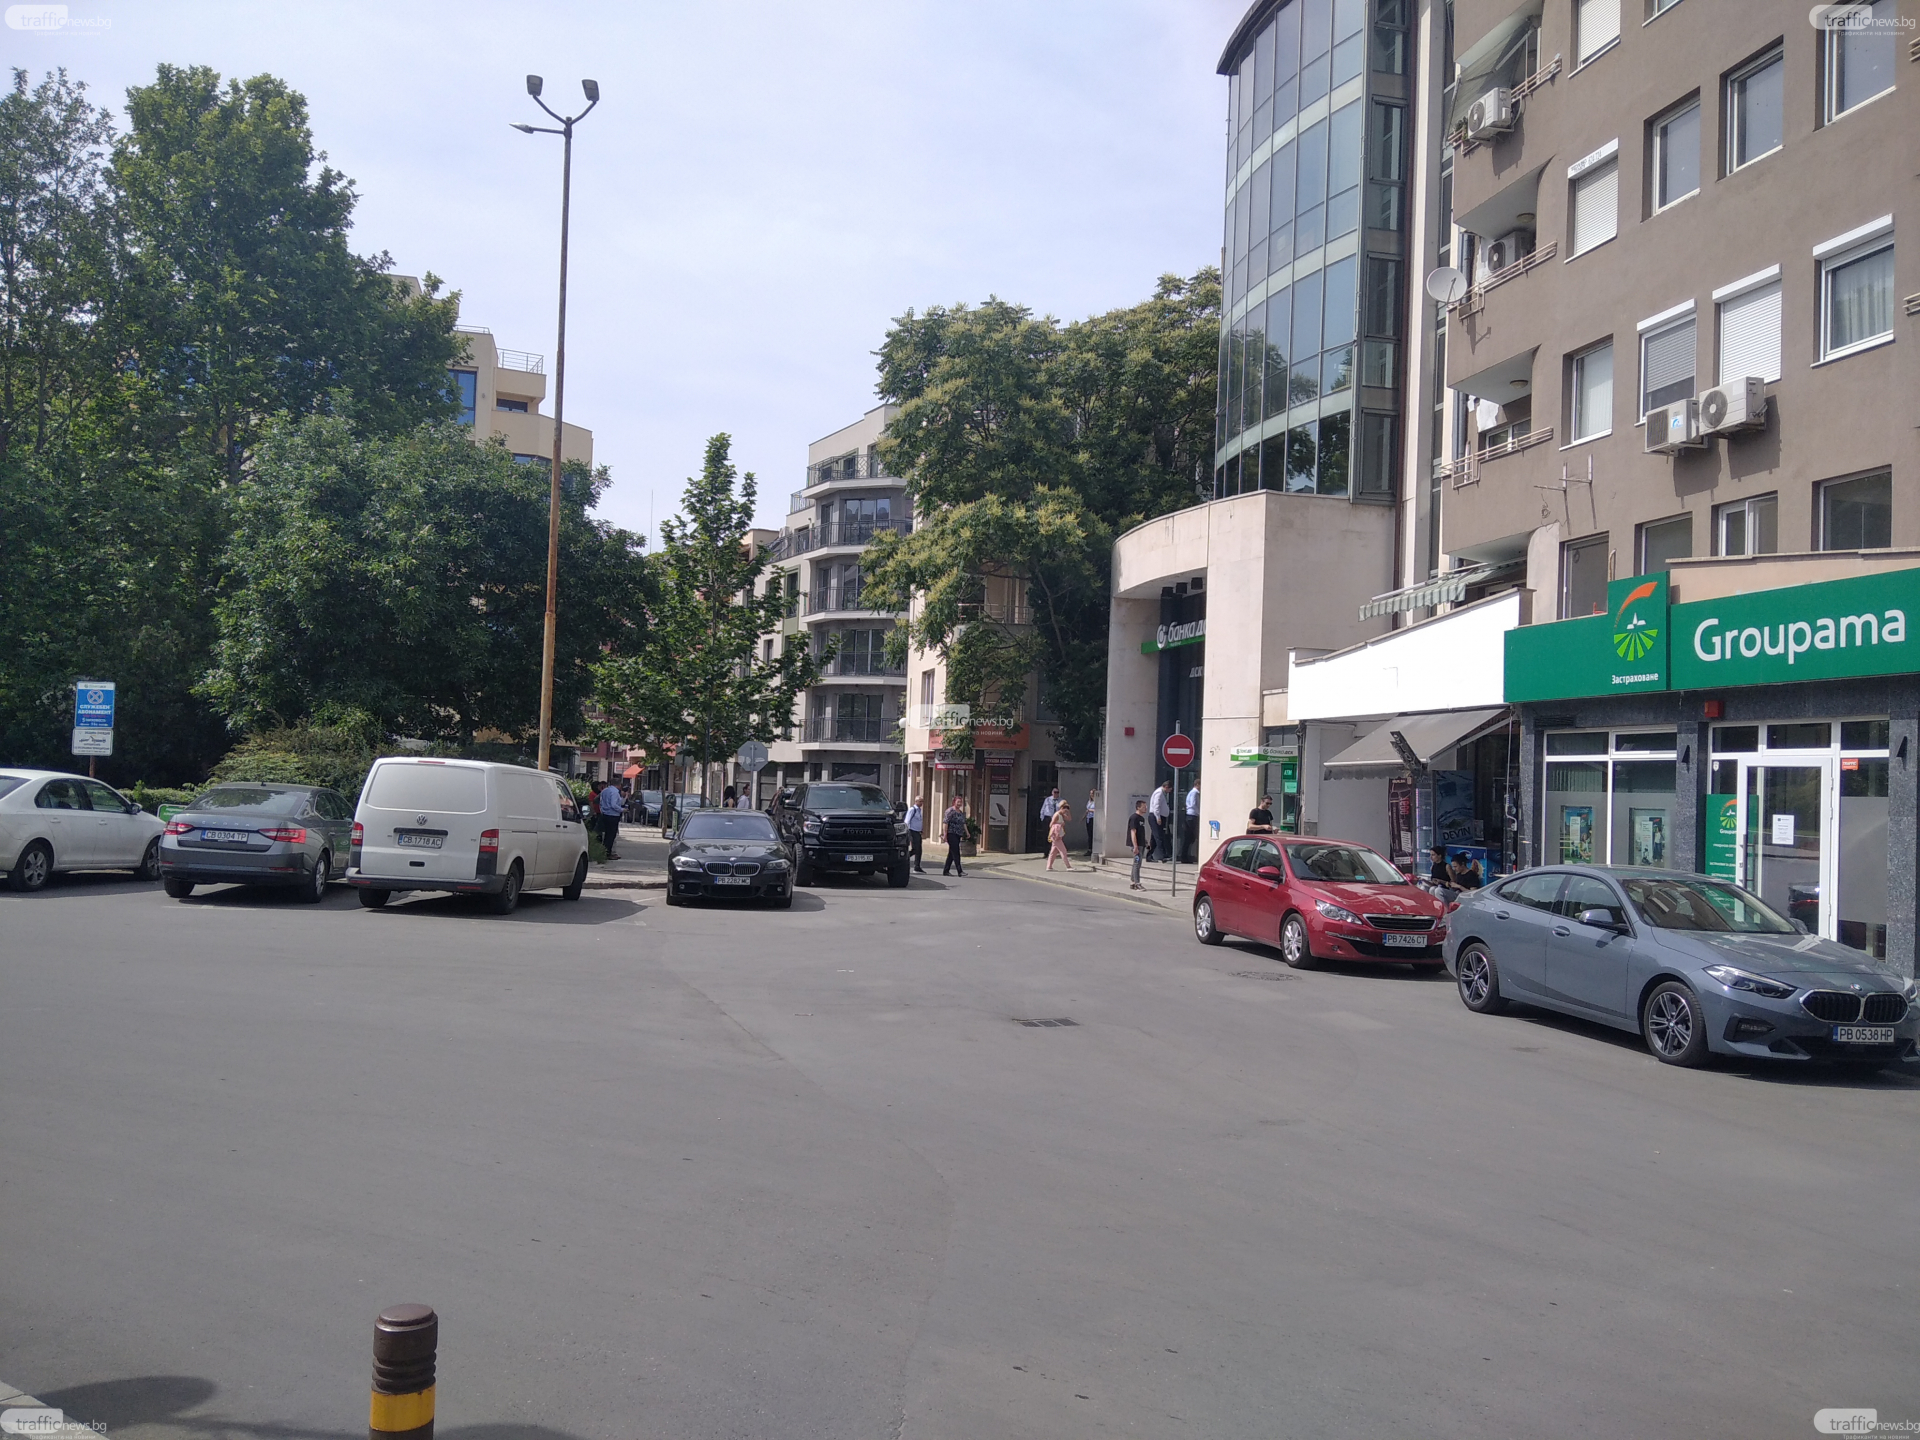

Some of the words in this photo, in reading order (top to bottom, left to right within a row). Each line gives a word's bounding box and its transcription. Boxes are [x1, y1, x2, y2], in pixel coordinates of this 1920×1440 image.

[1168, 621, 1196, 642] банка
[1694, 609, 1906, 664] Groupama
[1611, 673, 1659, 685] Застраховане
[1443, 826, 1471, 841] DEVIN
[1398, 935, 1416, 944] 7426
[1855, 1029, 1879, 1041] 0538
